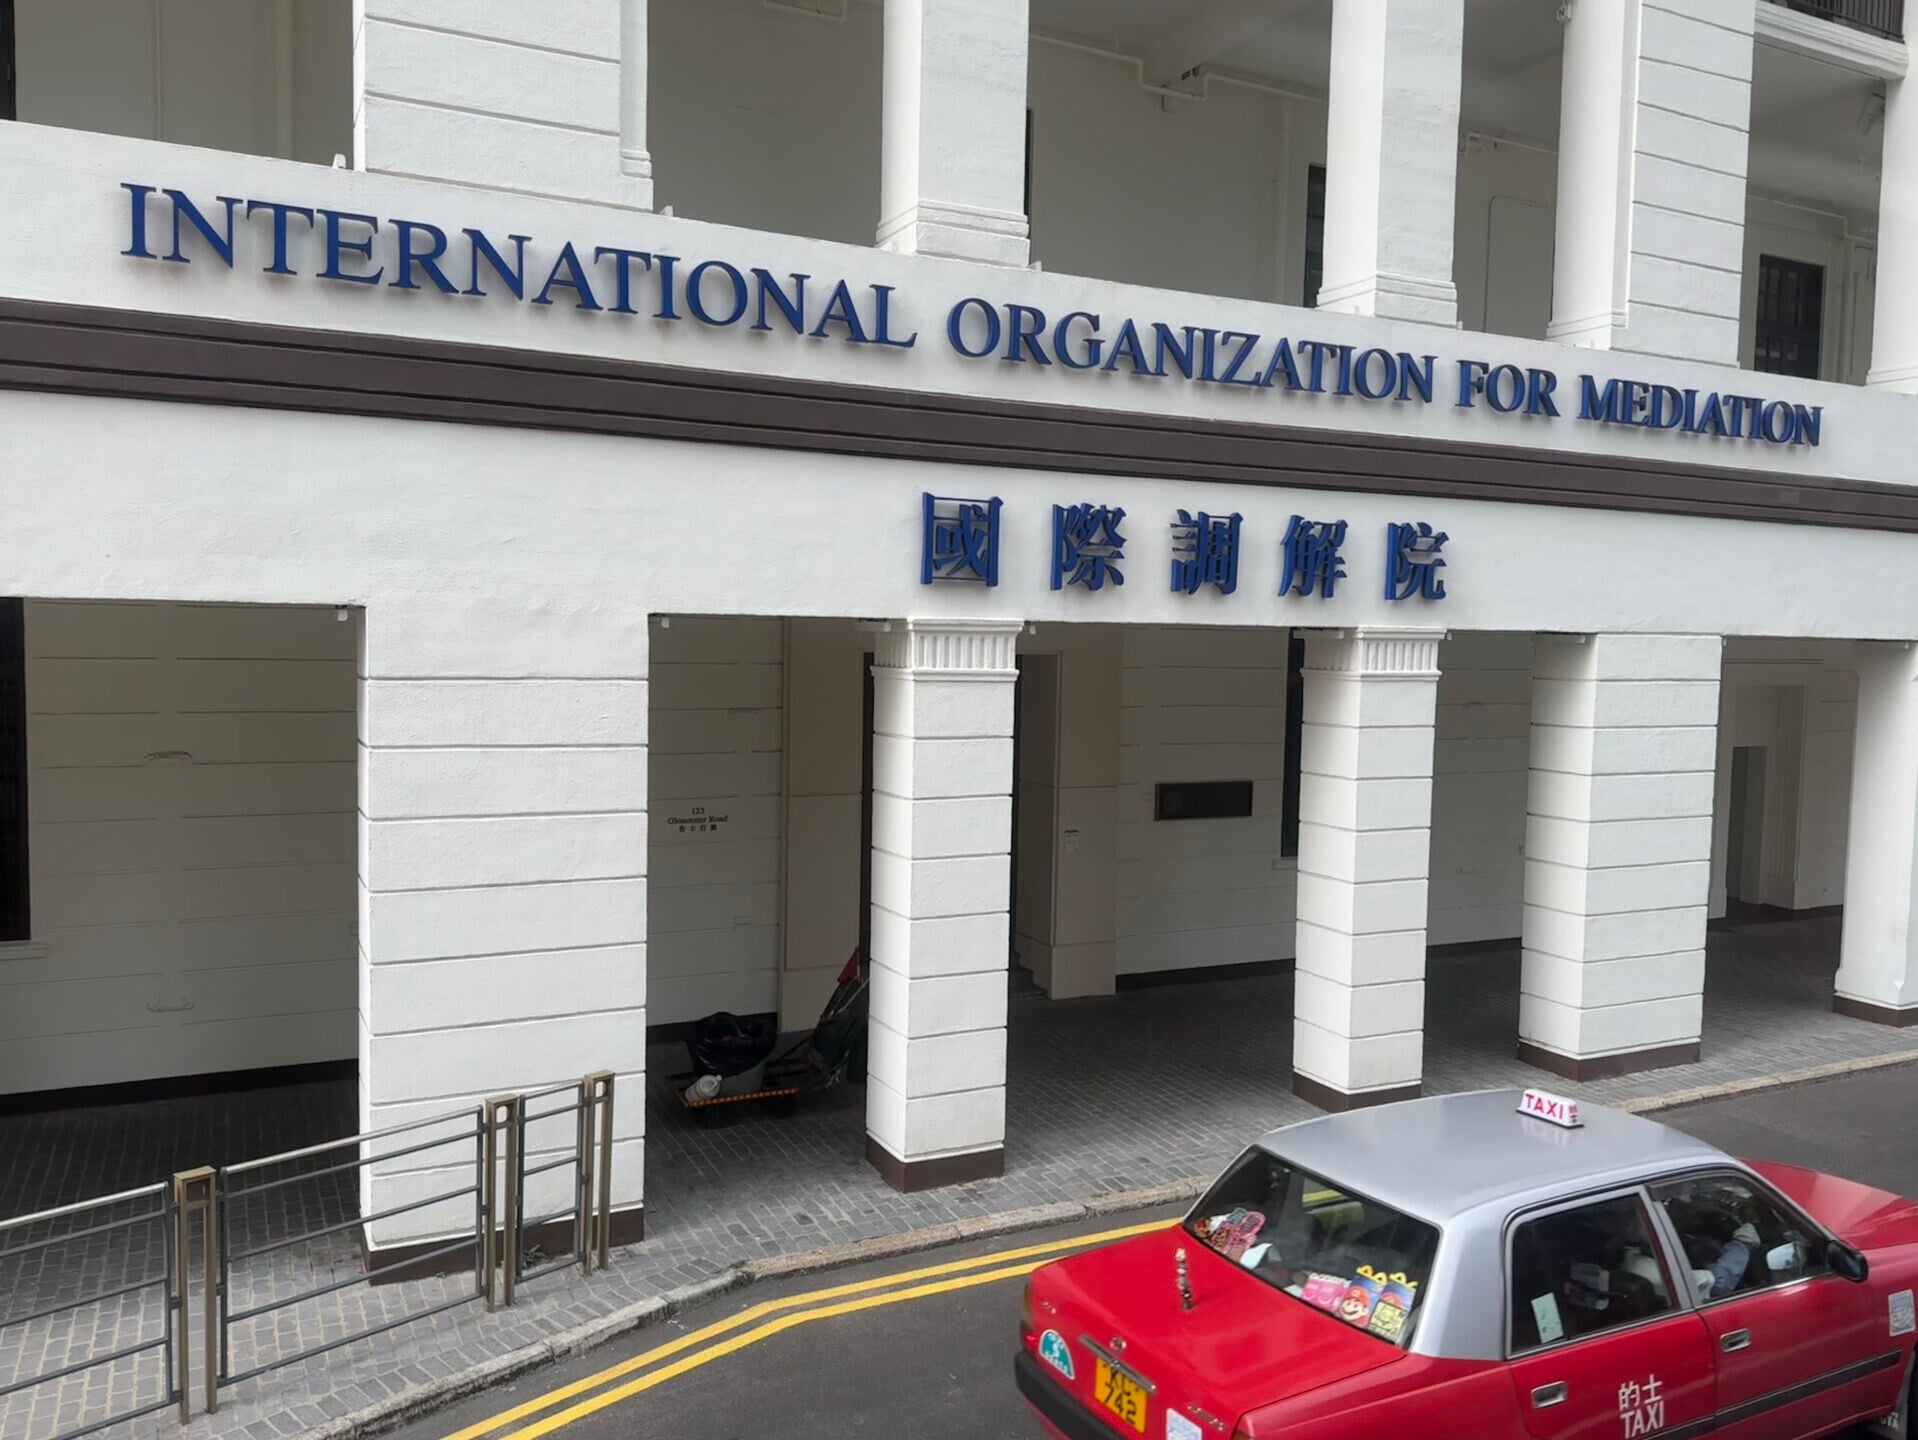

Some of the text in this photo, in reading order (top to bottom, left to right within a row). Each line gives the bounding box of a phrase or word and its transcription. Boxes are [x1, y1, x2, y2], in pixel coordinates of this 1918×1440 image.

[127, 185, 1821, 444] INTERNATIONAL ORGANIZATION FOR MEDIATION
[921, 492, 1448, 601] 國際調解院
[1525, 1093, 1563, 1119] TAXI
[1105, 1382, 1137, 1425] 742
[1618, 1374, 1663, 1411] 的士
[1620, 1400, 1664, 1439] TAXI
